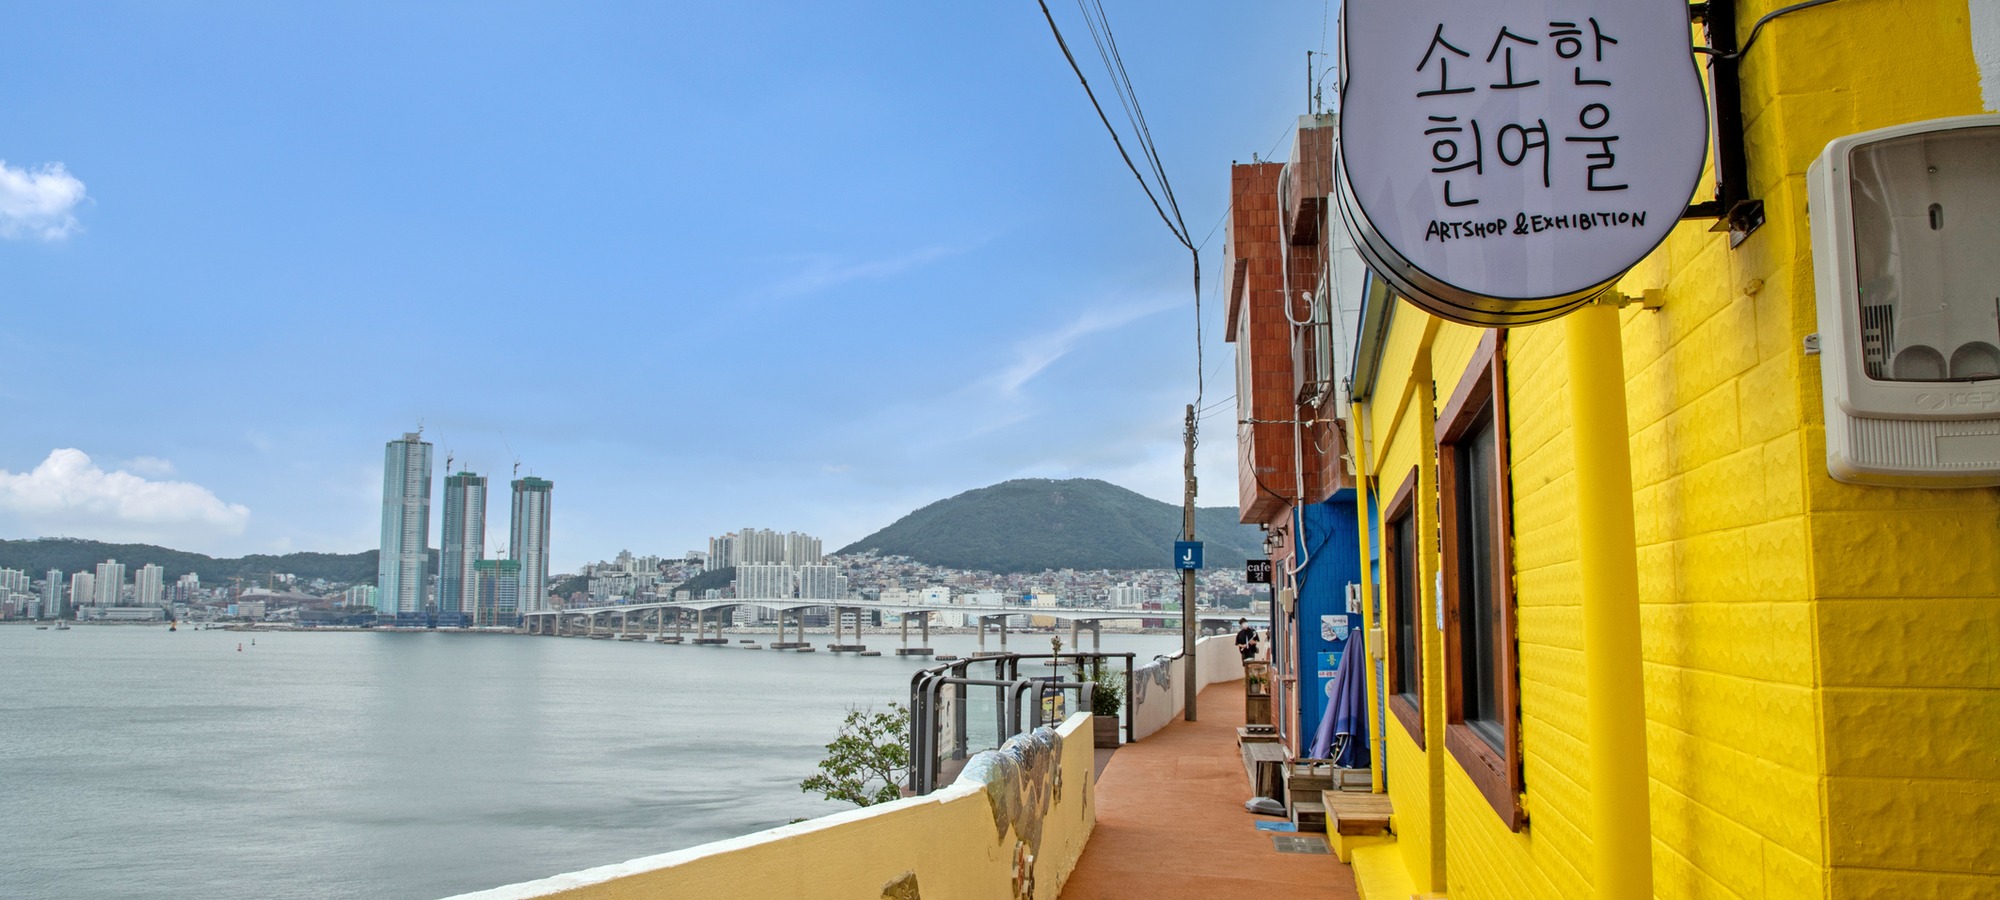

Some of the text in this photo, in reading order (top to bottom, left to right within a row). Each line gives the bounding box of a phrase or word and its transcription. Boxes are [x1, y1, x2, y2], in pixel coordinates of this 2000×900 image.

[1416, 17, 1618, 98] 소소한
[1424, 103, 1629, 207] 흰여울
[1425, 217, 1507, 243] ARTSHOP
[1183, 548, 1192, 561] J
[1247, 561, 1271, 572] cafe
